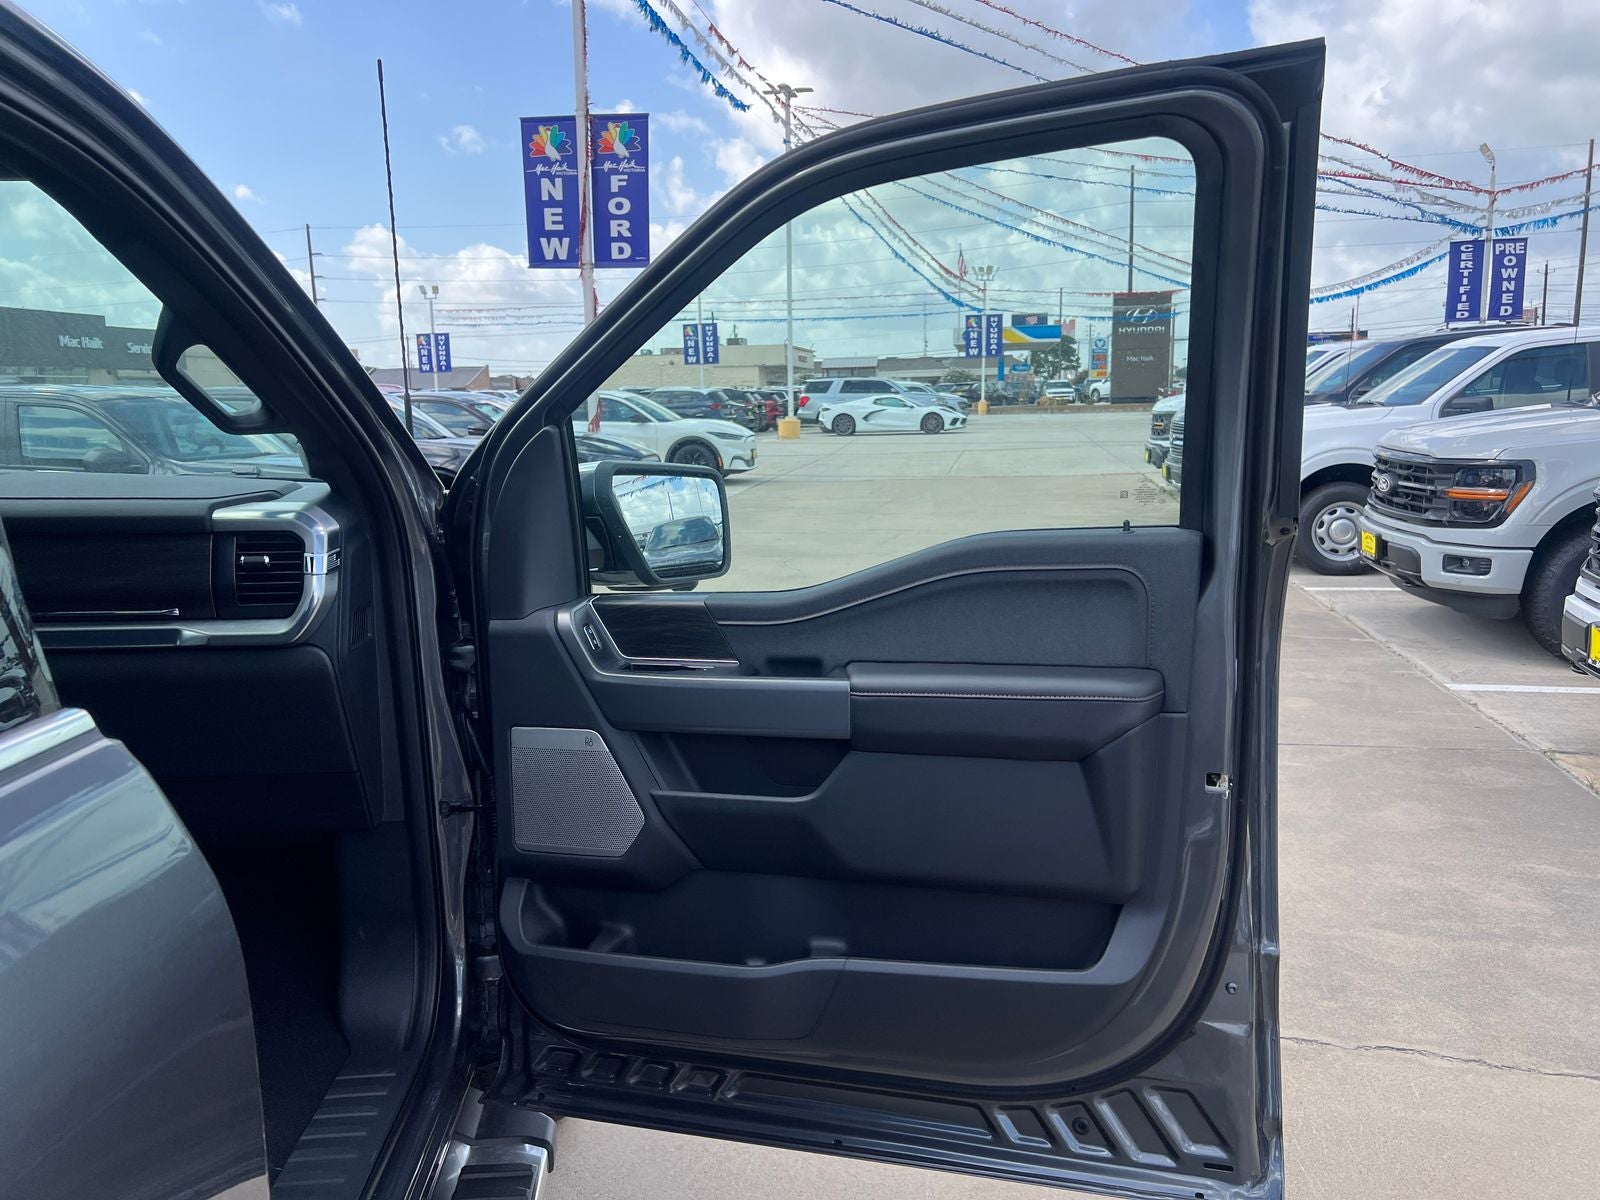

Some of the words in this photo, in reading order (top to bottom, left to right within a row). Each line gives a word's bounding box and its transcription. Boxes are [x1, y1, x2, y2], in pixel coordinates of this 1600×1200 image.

[540, 177, 569, 260] NEW
[608, 174, 632, 260] FORD
[1495, 242, 1525, 255] PRE
[1455, 244, 1474, 319] CERTIFIED
[1499, 255, 1518, 316] OWNED
[58, 335, 80, 348] Mac
[705, 325, 714, 363] HYUNDAI
[968, 331, 979, 356] NEW
[990, 316, 998, 355] HYUNDAI
[1118, 326, 1165, 335] HYUNDAI
[420, 349, 430, 372] NEW
[438, 335, 447, 371] HYUNDAI
[687, 340, 697, 364] NEW
